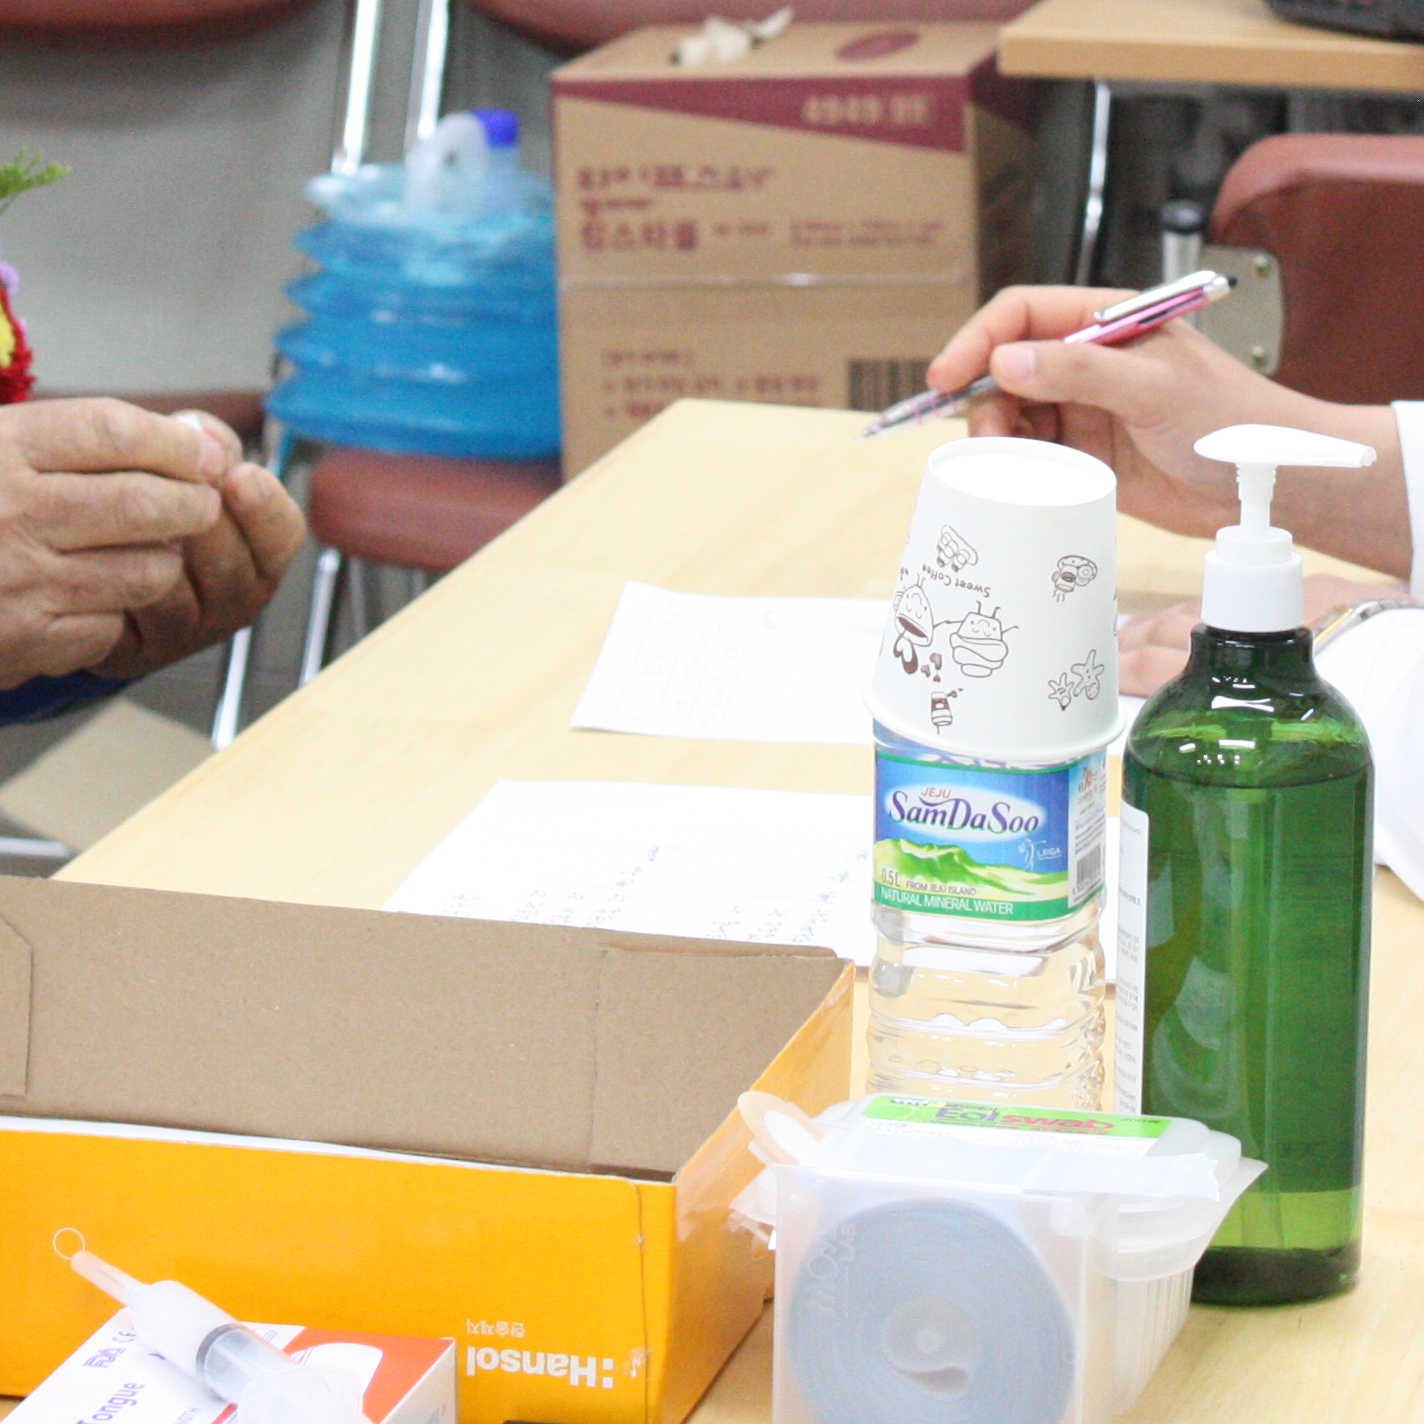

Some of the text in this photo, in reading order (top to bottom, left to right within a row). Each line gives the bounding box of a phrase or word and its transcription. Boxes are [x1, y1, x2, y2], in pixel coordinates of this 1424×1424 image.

[921, 563, 952, 587] Coffee
[954, 578, 992, 598] Sweet
[921, 787, 951, 798] JEJU
[889, 790, 1039, 835] SamDaSoo
[906, 880, 928, 892] FROM
[948, 886, 977, 897] ISLAND
[881, 887, 1014, 915] NATURAL MINERAL WATER
[467, 1318, 526, 1339] 한솔제지
